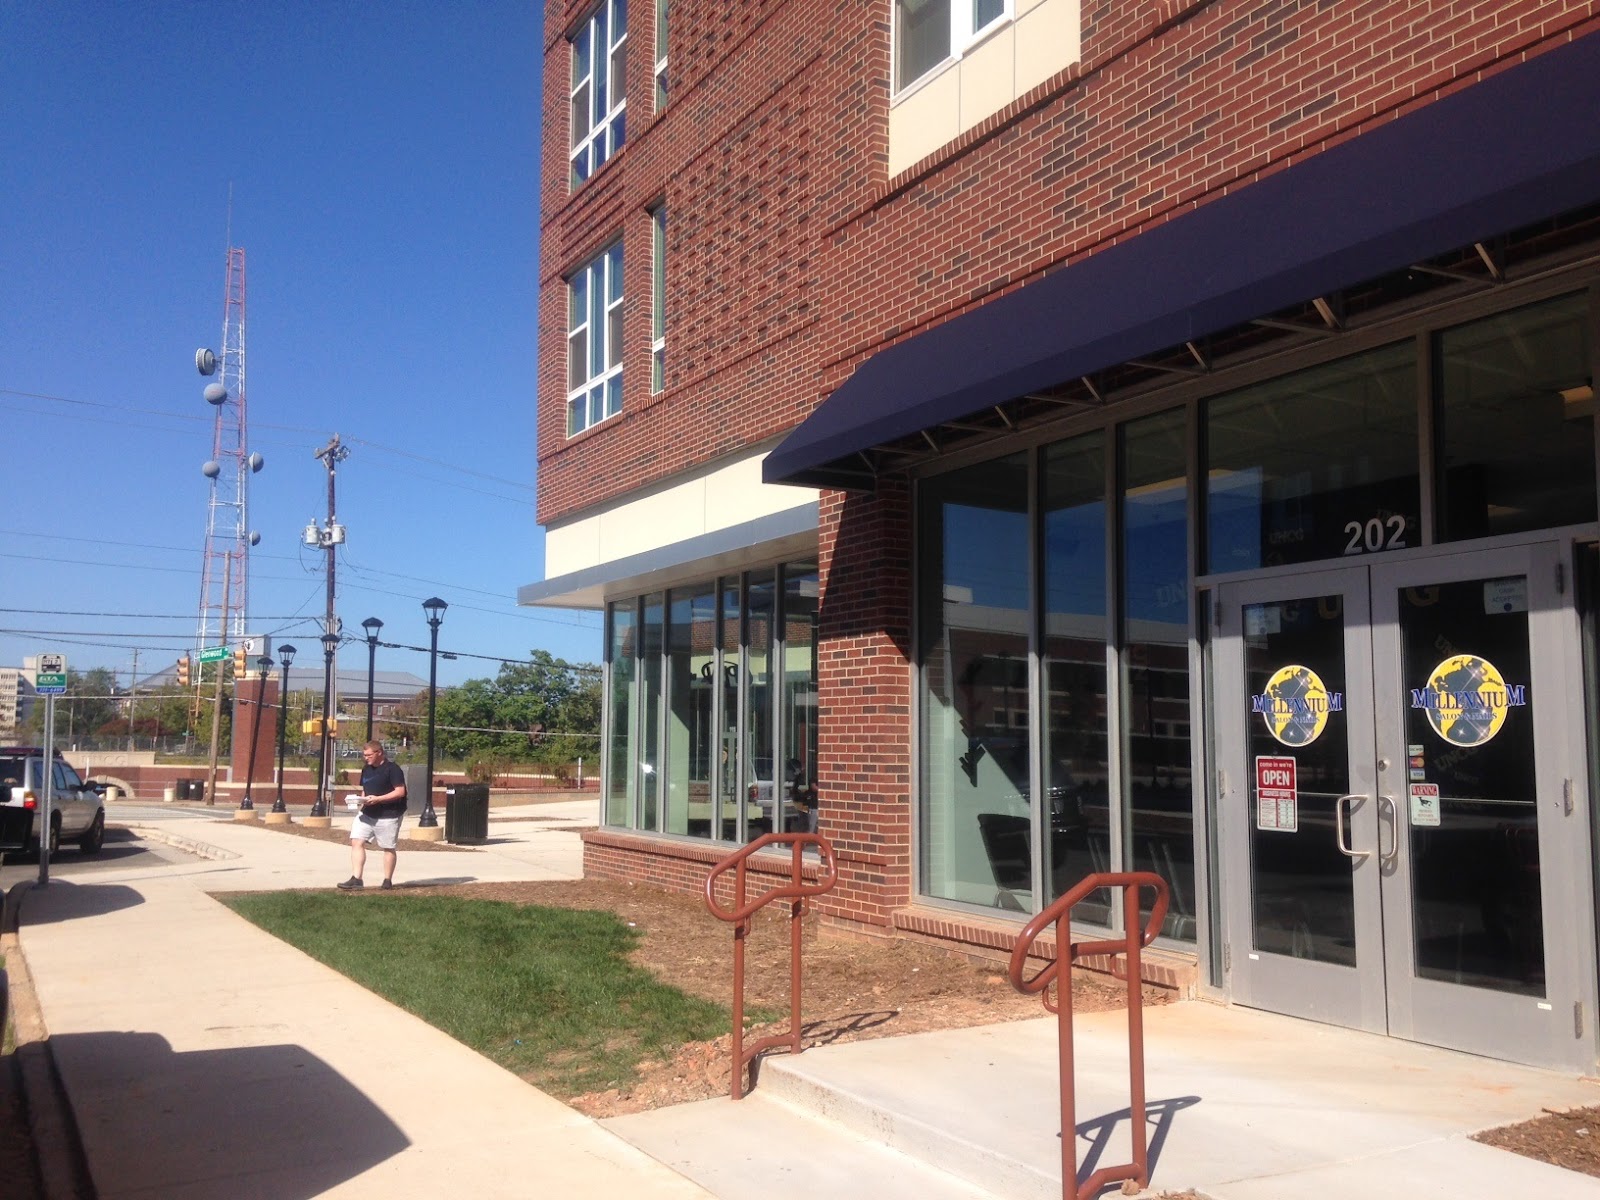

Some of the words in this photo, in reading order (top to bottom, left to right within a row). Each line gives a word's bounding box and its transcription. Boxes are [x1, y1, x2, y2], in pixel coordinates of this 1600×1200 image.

[1344, 514, 1406, 556] 202
[201, 648, 223, 659] Glenwood
[1252, 691, 1342, 714] MILLENNIUM
[1410, 683, 1526, 710] MILLENNIUM
[1271, 716, 1292, 724] SALON
[1436, 712, 1461, 721] SALON
[1472, 712, 1497, 721] NAILS
[1262, 769, 1290, 786] OPEN
